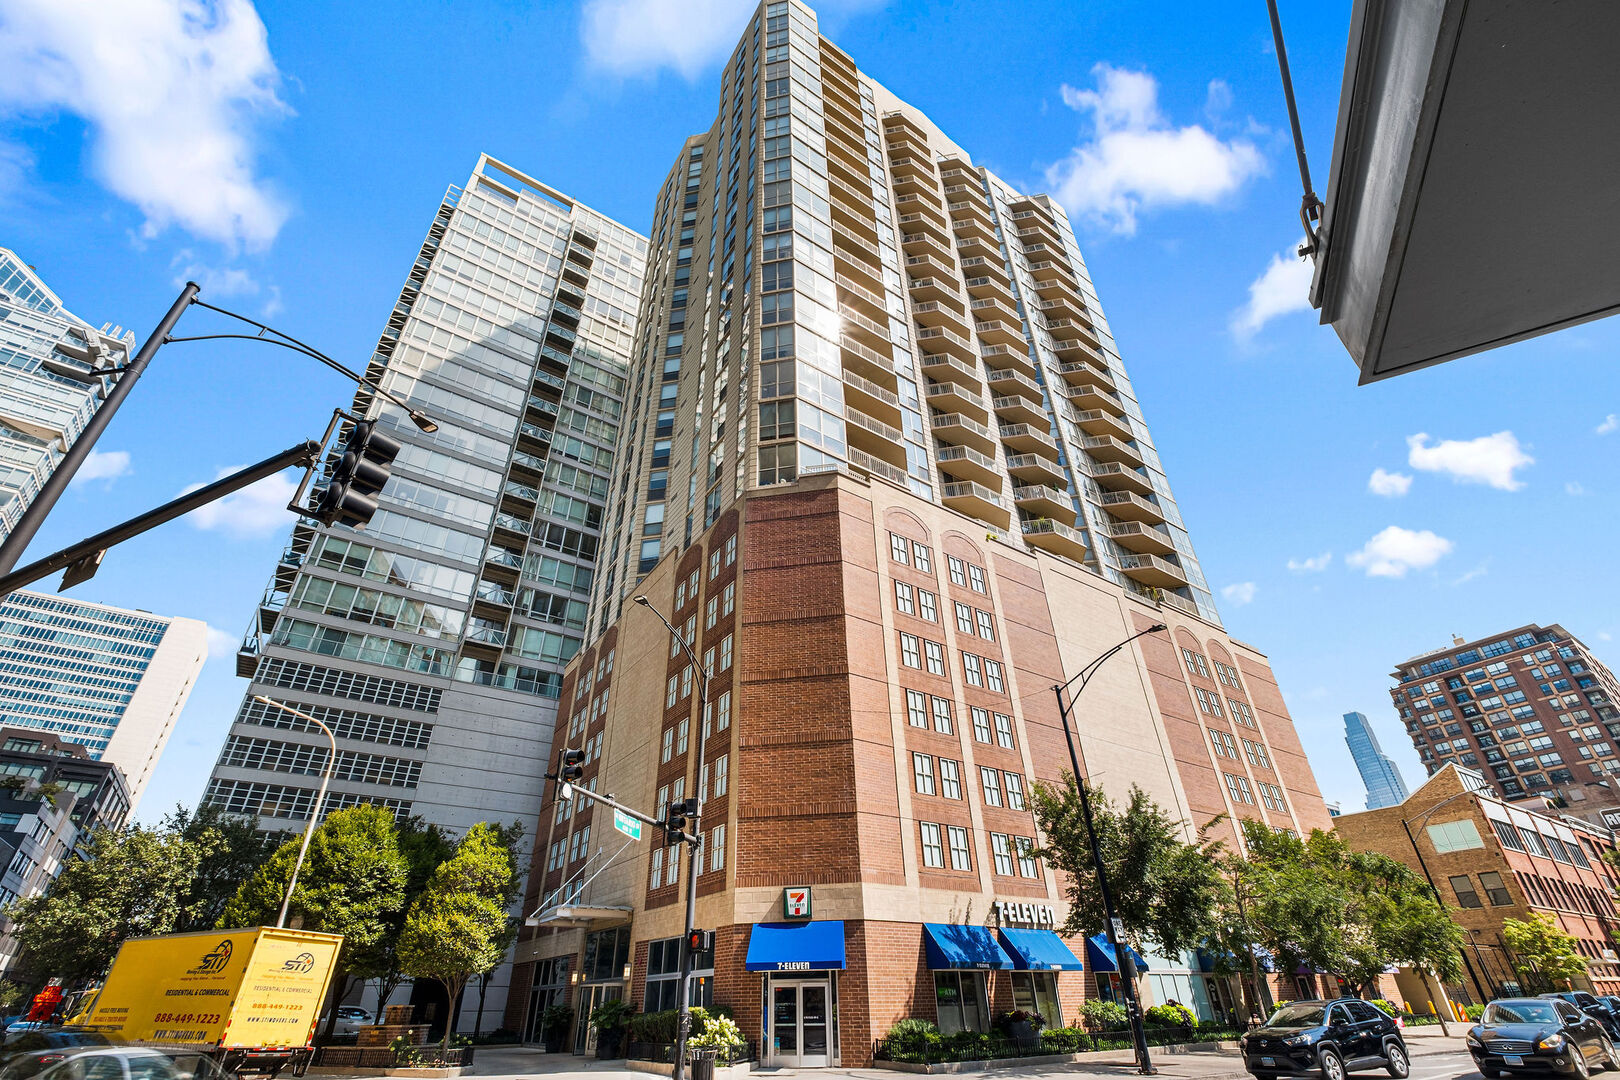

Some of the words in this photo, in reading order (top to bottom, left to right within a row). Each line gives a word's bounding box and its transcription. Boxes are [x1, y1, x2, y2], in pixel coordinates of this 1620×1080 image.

[790, 892, 805, 915] 7
[165, 989, 194, 997] RESIDENTIAL
[198, 988, 230, 997] COMMERCIAL
[254, 985, 281, 993] RESIDENTIAL
[944, 988, 957, 997] ATM
[252, 1003, 304, 1011] 888-449-1223
[154, 1012, 221, 1025] 888-449-1223
